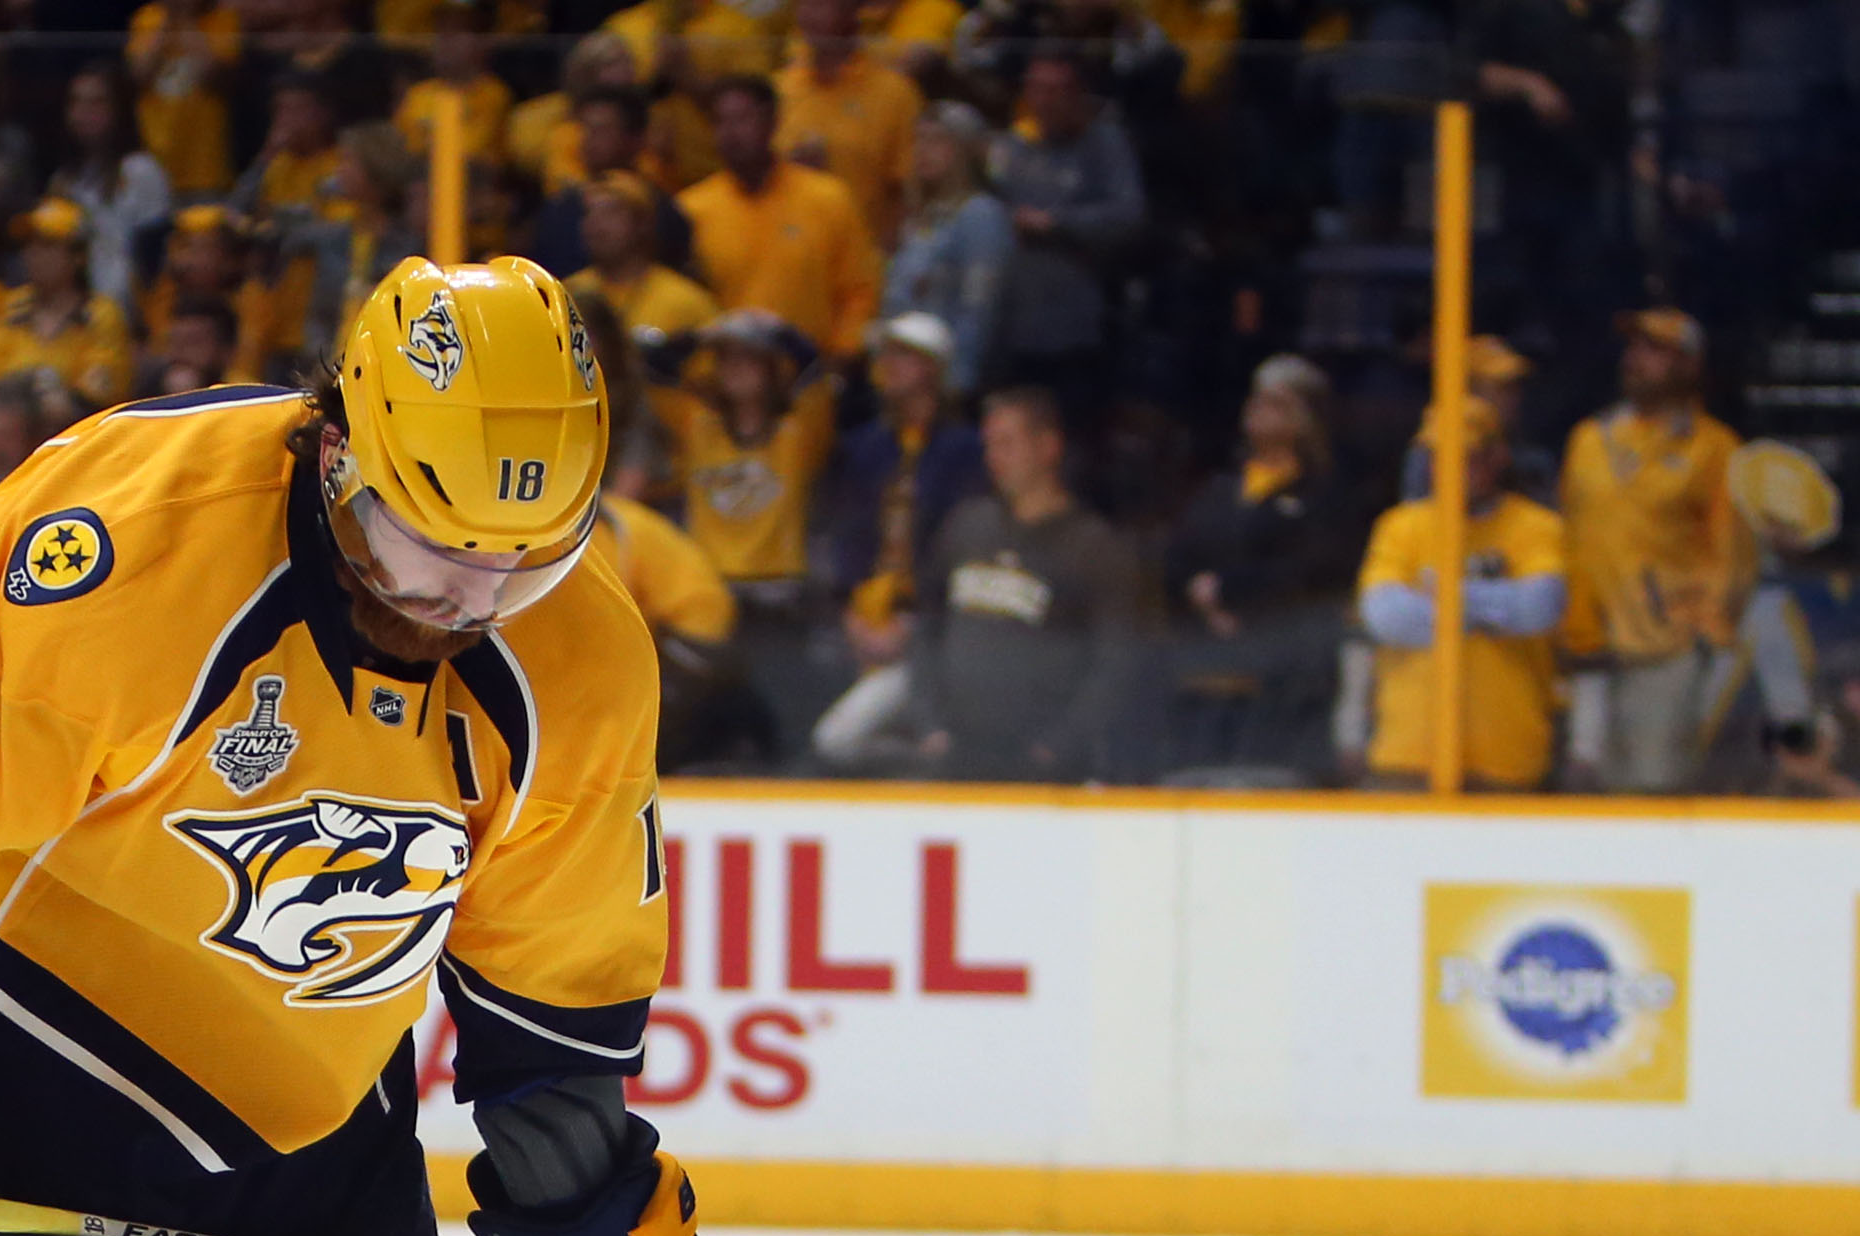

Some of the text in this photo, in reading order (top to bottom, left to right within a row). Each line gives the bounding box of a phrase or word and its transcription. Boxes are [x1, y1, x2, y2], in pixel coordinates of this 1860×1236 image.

[498, 457, 546, 503] 18
[376, 702, 398, 715] NHL
[220, 738, 290, 754] FINAL
[636, 792, 667, 906] 1
[665, 836, 1030, 995] ILL
[84, 1215, 106, 1235] 18
